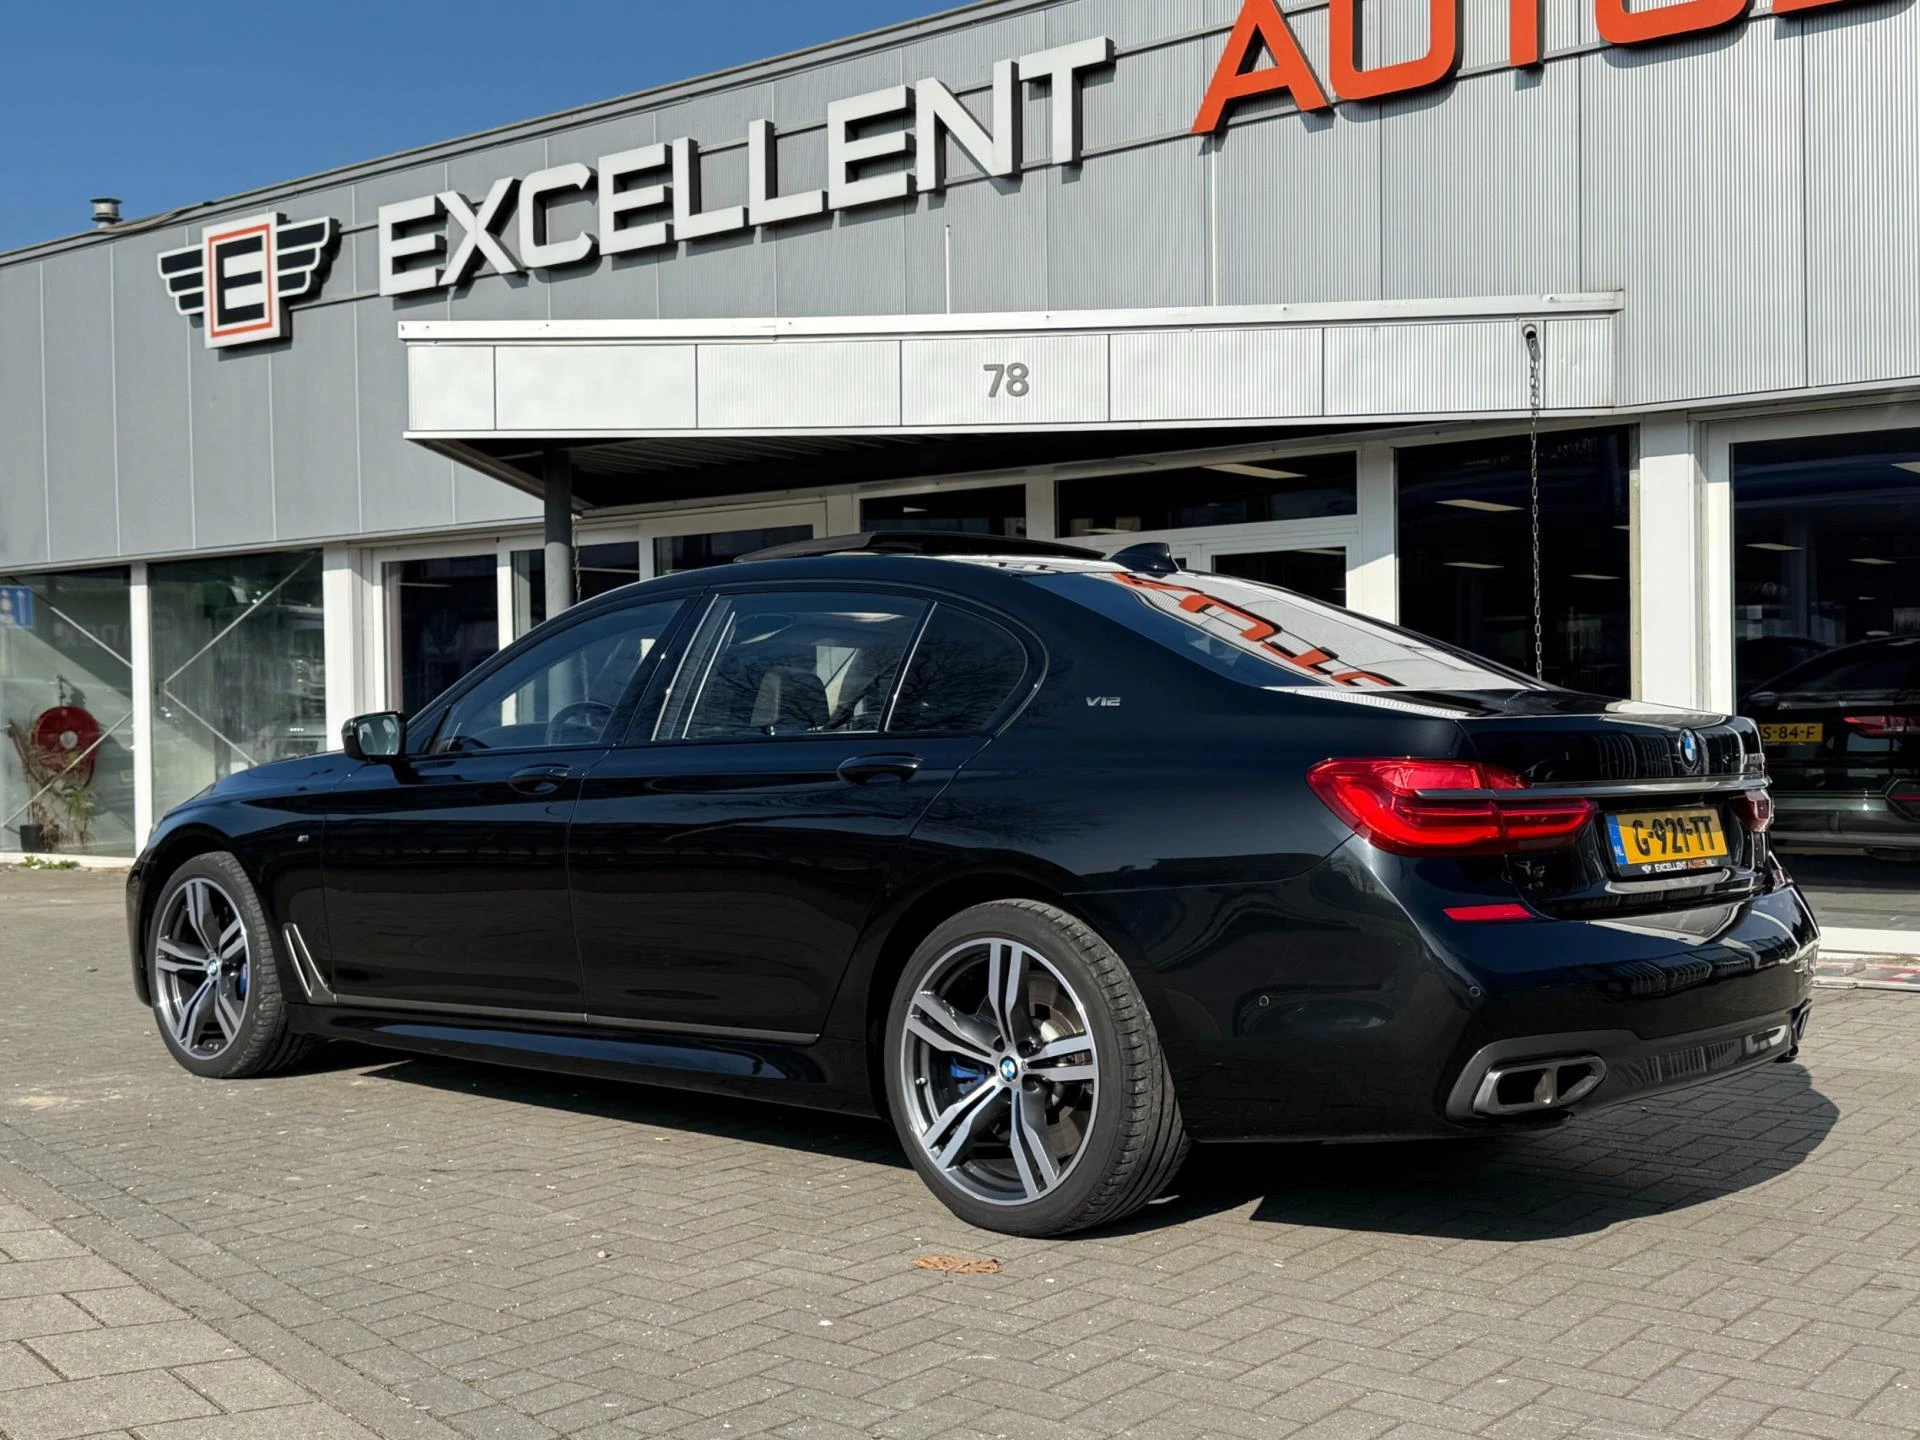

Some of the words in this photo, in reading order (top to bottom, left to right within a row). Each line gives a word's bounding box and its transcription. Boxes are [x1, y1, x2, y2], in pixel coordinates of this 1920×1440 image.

[378, 35, 1113, 297] EXCELLENT
[216, 234, 264, 325] E
[983, 362, 1030, 398] 78
[1085, 696, 1121, 707] V12
[1762, 726, 1815, 740] S-84-F
[1632, 816, 1715, 856] G-921-TT
